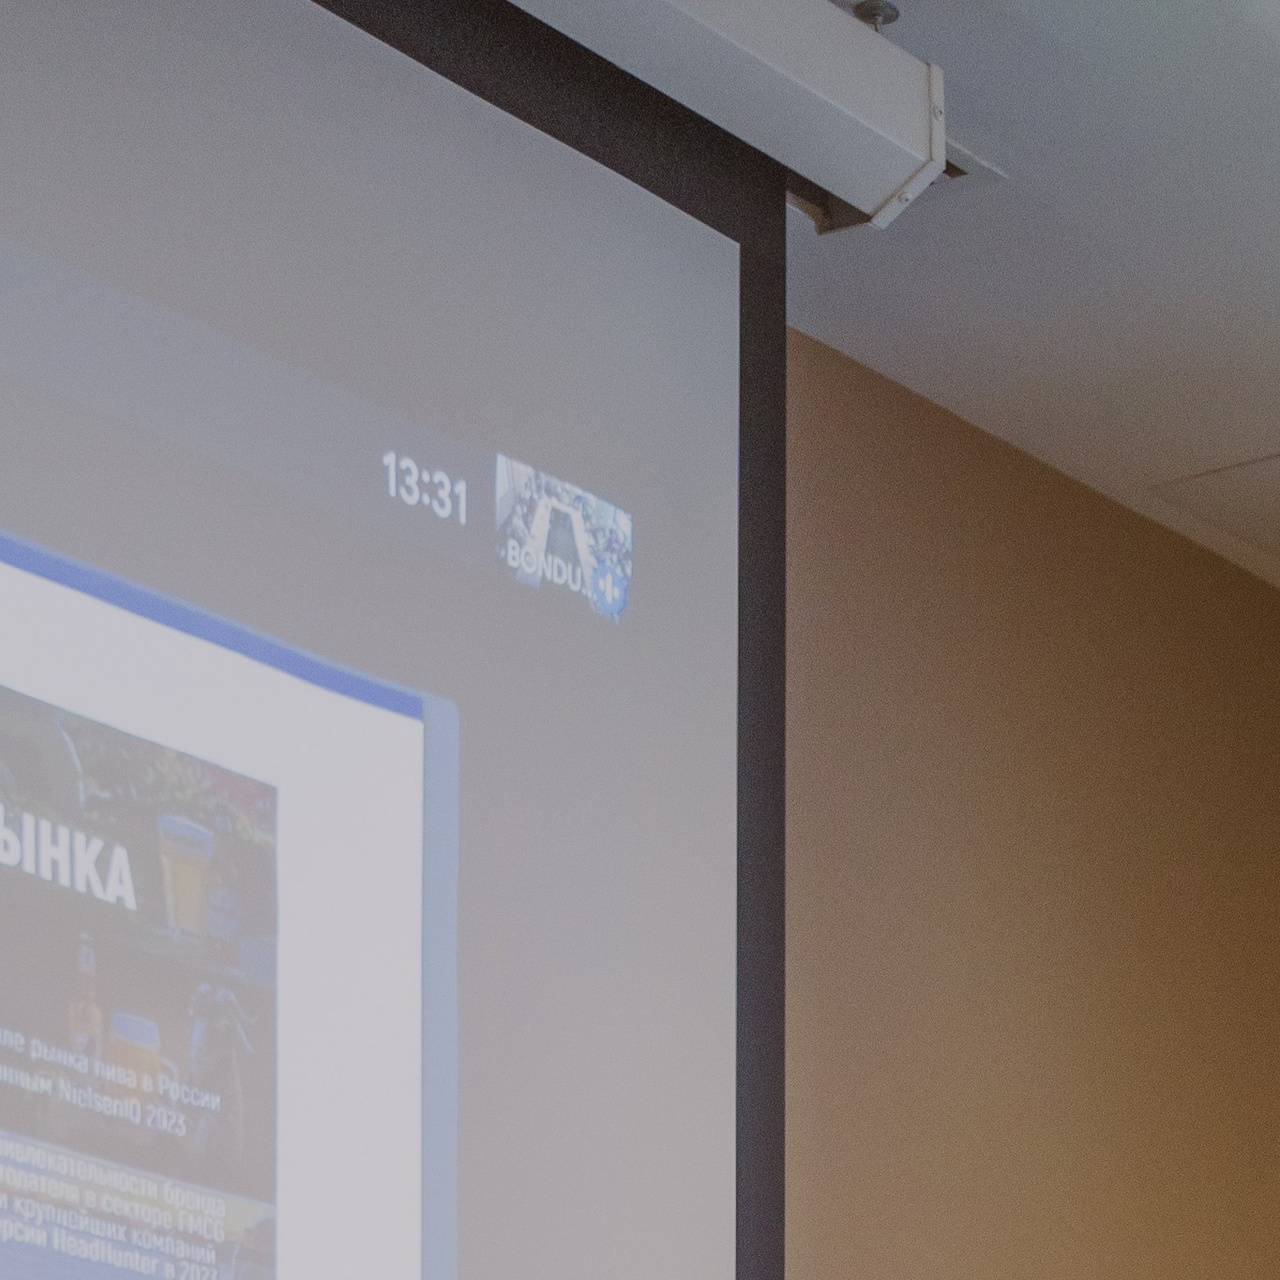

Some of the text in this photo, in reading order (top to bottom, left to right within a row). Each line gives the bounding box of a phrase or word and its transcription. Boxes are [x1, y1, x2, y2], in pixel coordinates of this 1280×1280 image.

[381, 451, 467, 525] 13:31
[0, 1028, 221, 1111] ле рынка пива в России
[0, 1064, 53, 1097] нным
[146, 1103, 187, 1136] 2023
[0, 1137, 226, 1218] ивлекательности бренда
[0, 1218, 47, 1246] рсии
[52, 1227, 159, 1276] HeadHunter
[164, 1261, 176, 1280] в
[14, 1196, 127, 1242] крупнейших
[131, 1229, 216, 1265] компаний
[84, 1189, 97, 1208] в
[101, 1194, 172, 1231] секторе
[178, 1209, 225, 1243] FMCG
